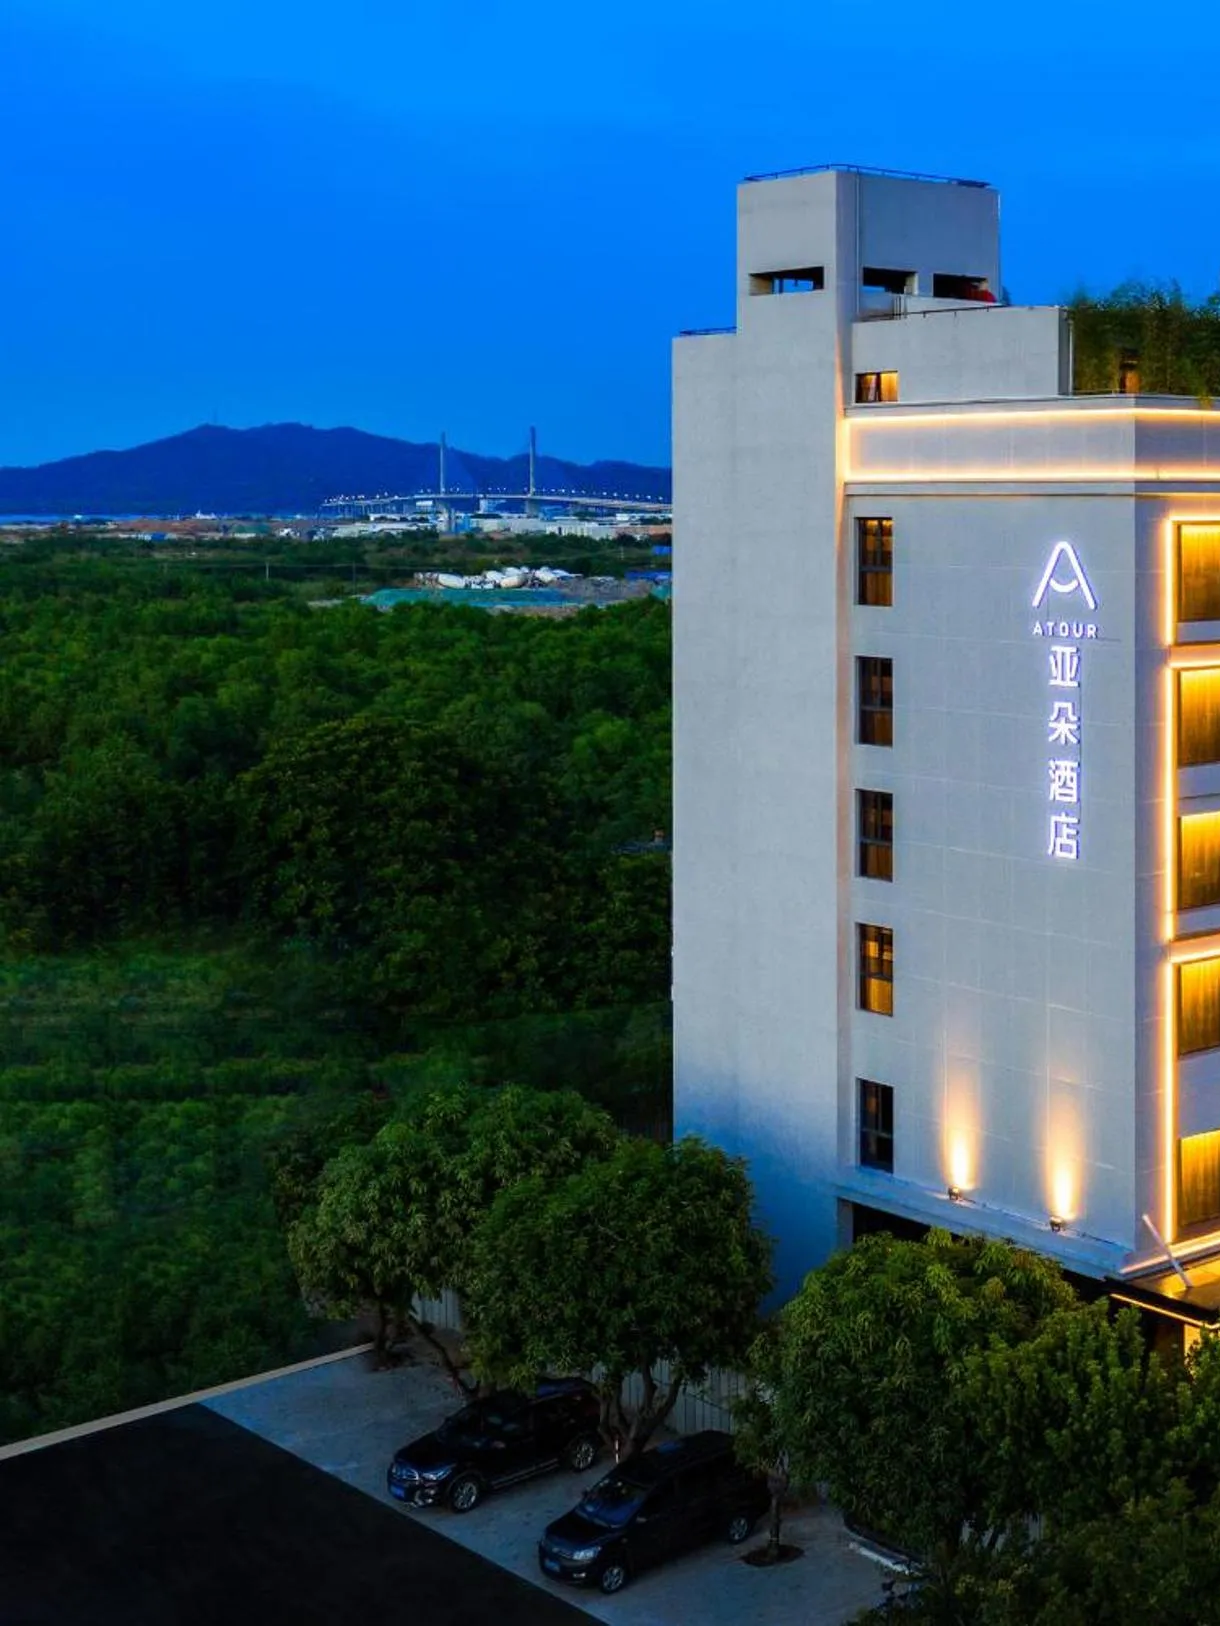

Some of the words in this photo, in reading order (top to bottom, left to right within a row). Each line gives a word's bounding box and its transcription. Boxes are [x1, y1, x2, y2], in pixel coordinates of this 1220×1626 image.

[1033, 621, 1098, 638] ATOUR
[1048, 646, 1080, 860] 亚朵酒店
